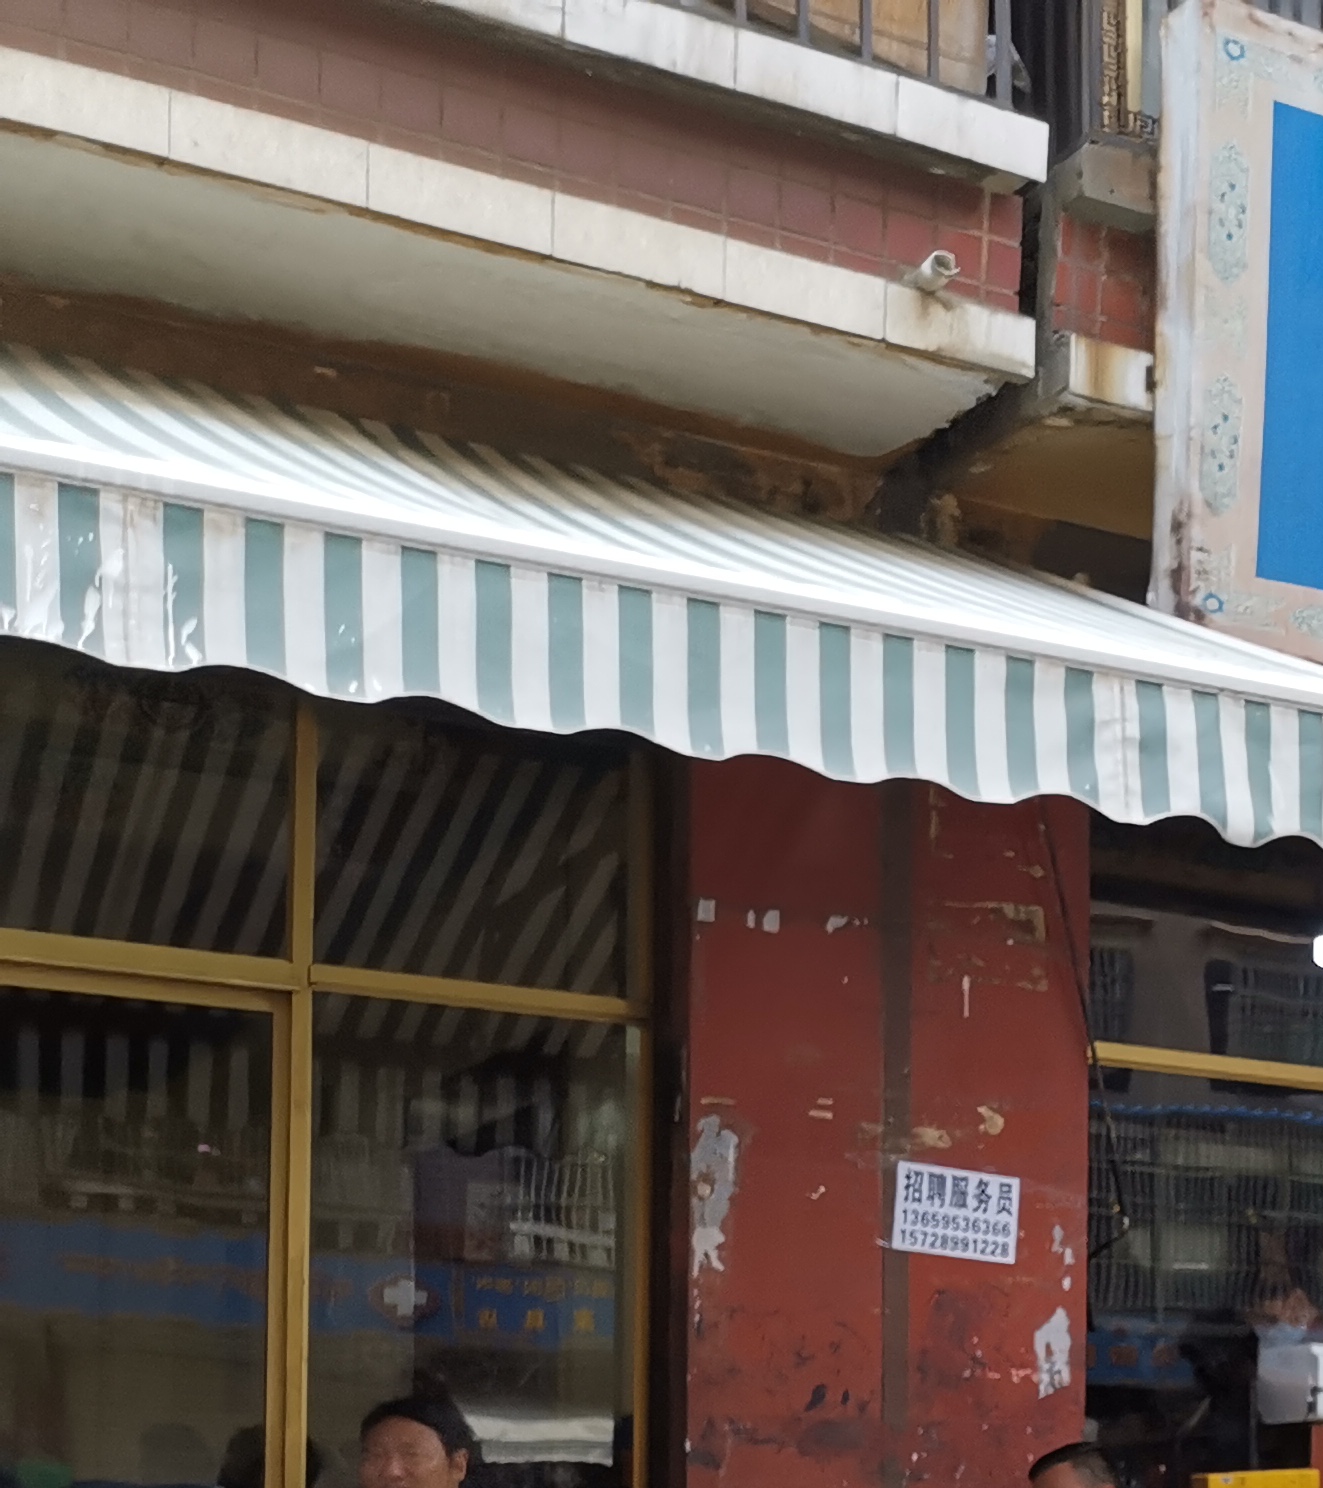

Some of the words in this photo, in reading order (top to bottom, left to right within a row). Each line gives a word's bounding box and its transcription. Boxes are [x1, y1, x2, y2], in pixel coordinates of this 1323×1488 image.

[903, 1168, 1013, 1217] 招聘服务员
